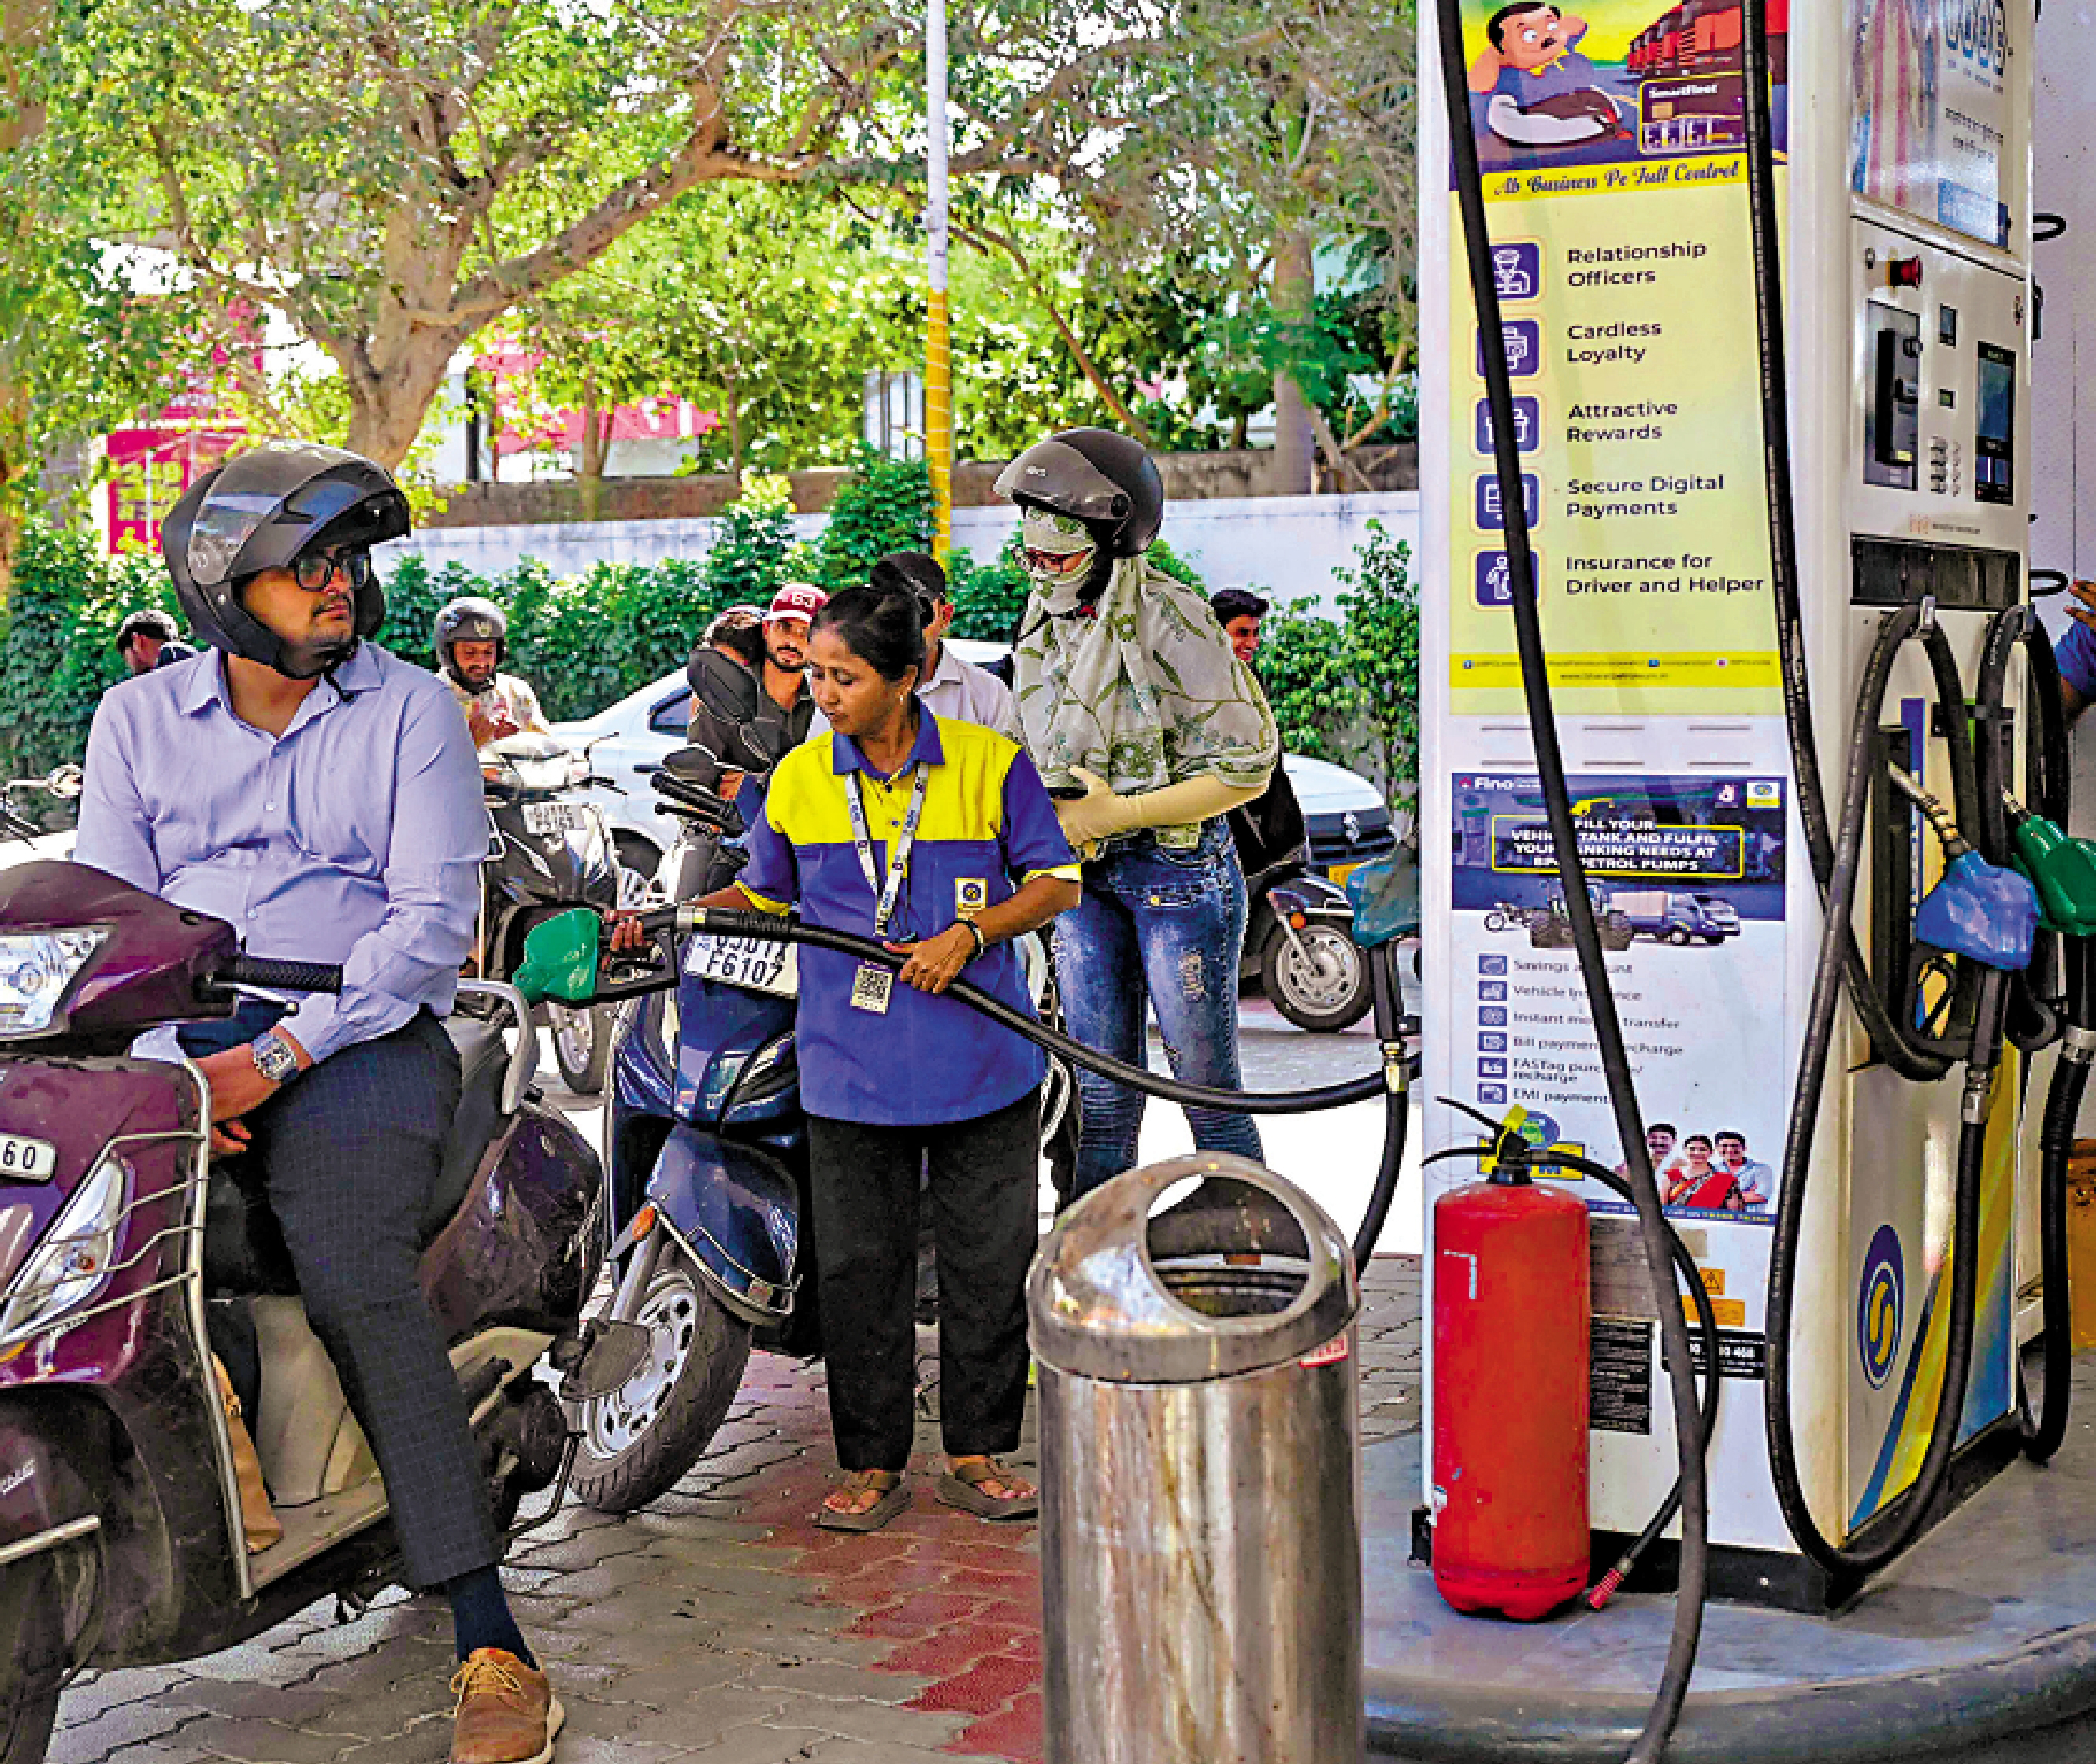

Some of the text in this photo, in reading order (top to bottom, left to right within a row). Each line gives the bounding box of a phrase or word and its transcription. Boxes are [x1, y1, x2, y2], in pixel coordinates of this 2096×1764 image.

[1527, 175, 1597, 192] Business
[1632, 165, 1670, 186] Full
[1675, 160, 1740, 181] Control
[1567, 241, 1707, 263] Relationship
[1567, 269, 1656, 287] Officers
[1567, 321, 1662, 339] Cardless
[1567, 343, 1647, 366] Loyalty
[1567, 399, 1677, 419] Attractive
[1567, 424, 1662, 442] Rewards
[1567, 474, 1724, 494] Secure Digital
[1567, 502, 1677, 520] Payments
[1567, 552, 1714, 570] Insurance for
[1567, 577, 1764, 595] Driver and Helper
[1474, 777, 1514, 791] Fino
[1575, 819, 1654, 830] FILL YOUR
[1579, 833, 1627, 843] TANK
[1627, 834, 1661, 844] AND
[1639, 847, 1691, 858] NEEDS
[1695, 847, 1716, 858] AT
[1642, 859, 1699, 871] PUMPS
[706, 952, 784, 987] F6107
[1514, 960, 1569, 973] Savings
[1514, 986, 1564, 996] Vehicle
[1514, 1013, 1563, 1024] Instant
[1623, 1017, 1679, 1028] transfer
[1514, 1036, 1535, 1047] Bill
[1514, 1058, 1564, 1073] FASTag
[1514, 1071, 1578, 1084] recharge
[1514, 1088, 1540, 1099] EMI
[3, 1141, 36, 1169] 60
